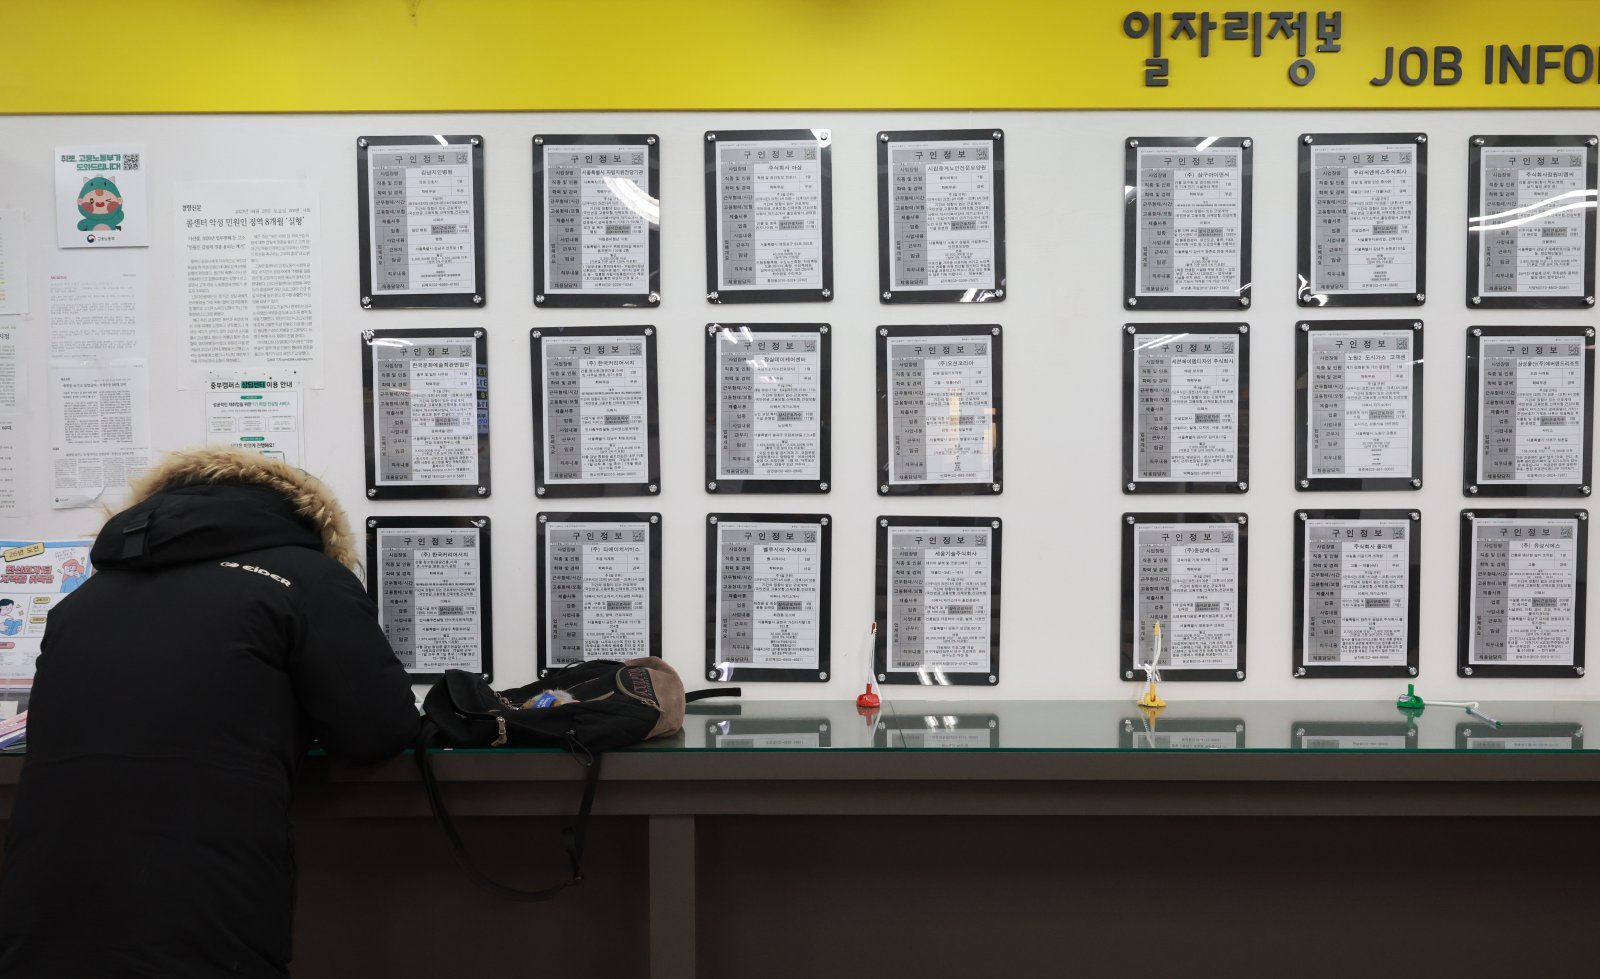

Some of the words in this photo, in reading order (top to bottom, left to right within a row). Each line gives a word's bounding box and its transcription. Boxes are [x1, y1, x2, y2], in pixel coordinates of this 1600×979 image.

[1123, 10, 1342, 87] 일자리정보
[1369, 46, 1463, 86] JOB
[1484, 43, 1600, 85] INFO
[79, 154, 121, 162] 고용노동부가
[76, 163, 121, 171] 도와드립니다!
[186, 218, 208, 228] 콜센터
[209, 218, 224, 227] 악성
[226, 218, 247, 227] 민원인
[249, 218, 263, 227] 징역
[264, 217, 284, 226] 8개월
[210, 381, 240, 389] 중부캠퍼스
